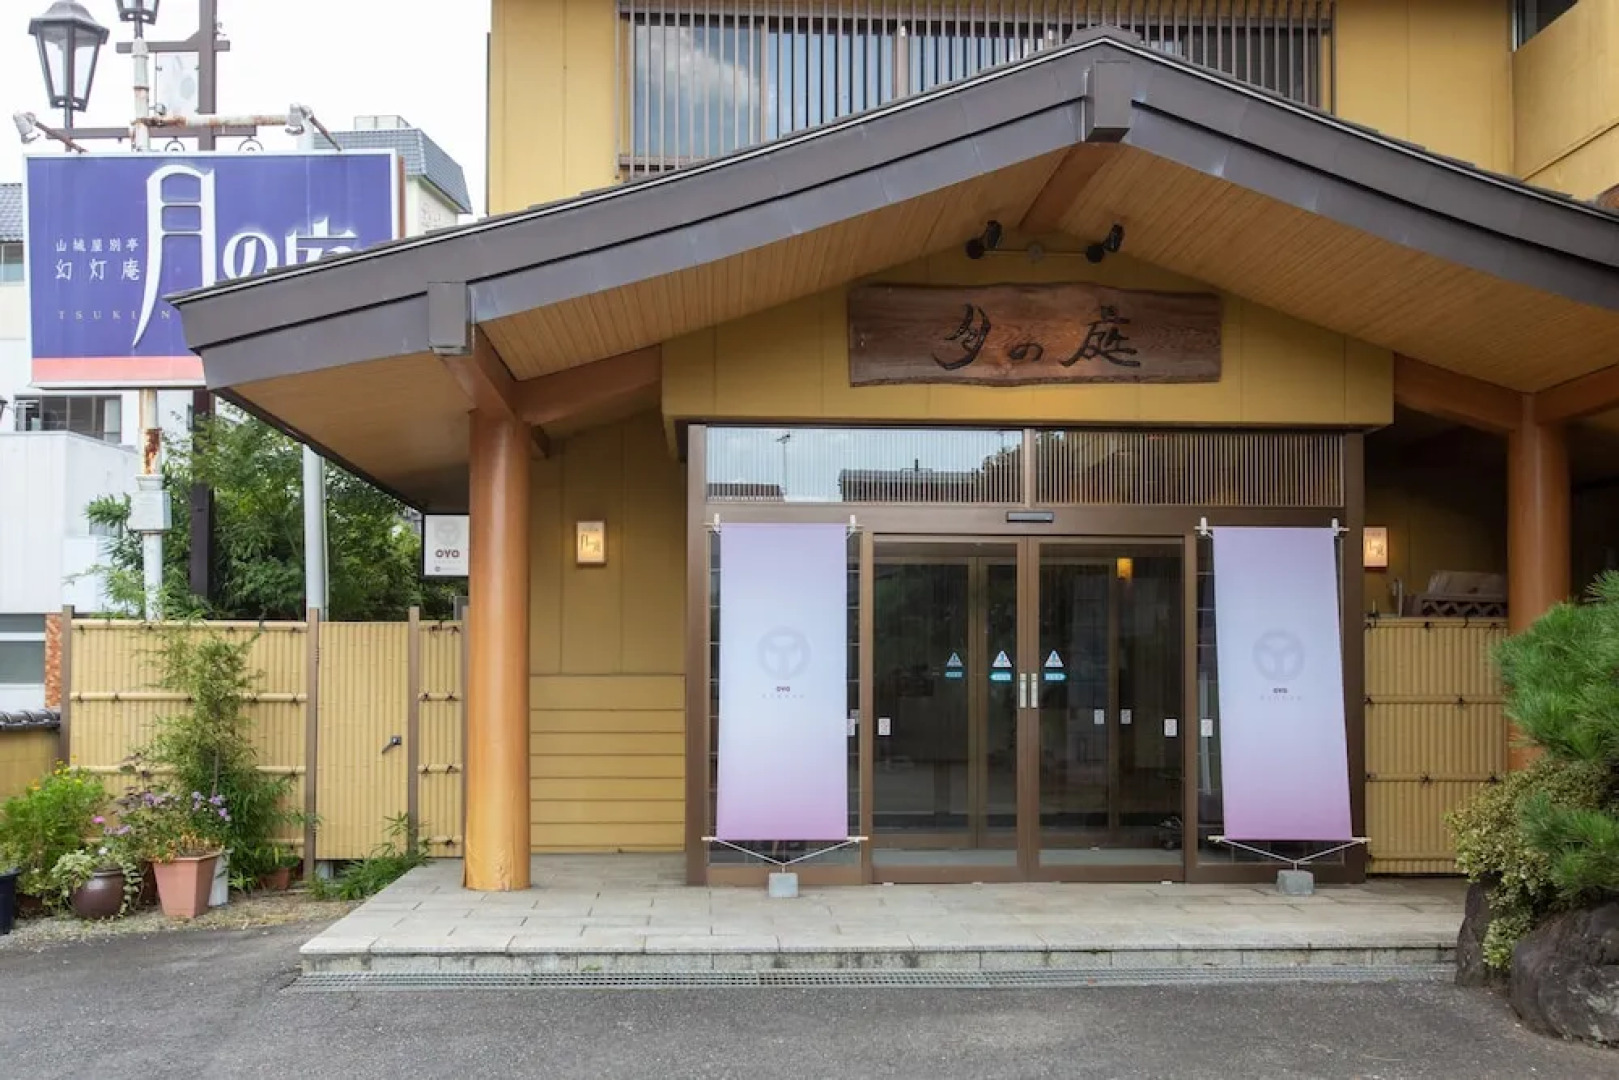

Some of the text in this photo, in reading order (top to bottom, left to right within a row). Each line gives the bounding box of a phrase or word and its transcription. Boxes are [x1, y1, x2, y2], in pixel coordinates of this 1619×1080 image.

[55, 258, 140, 281] 幻灯庵
[435, 549, 460, 558] OYO
